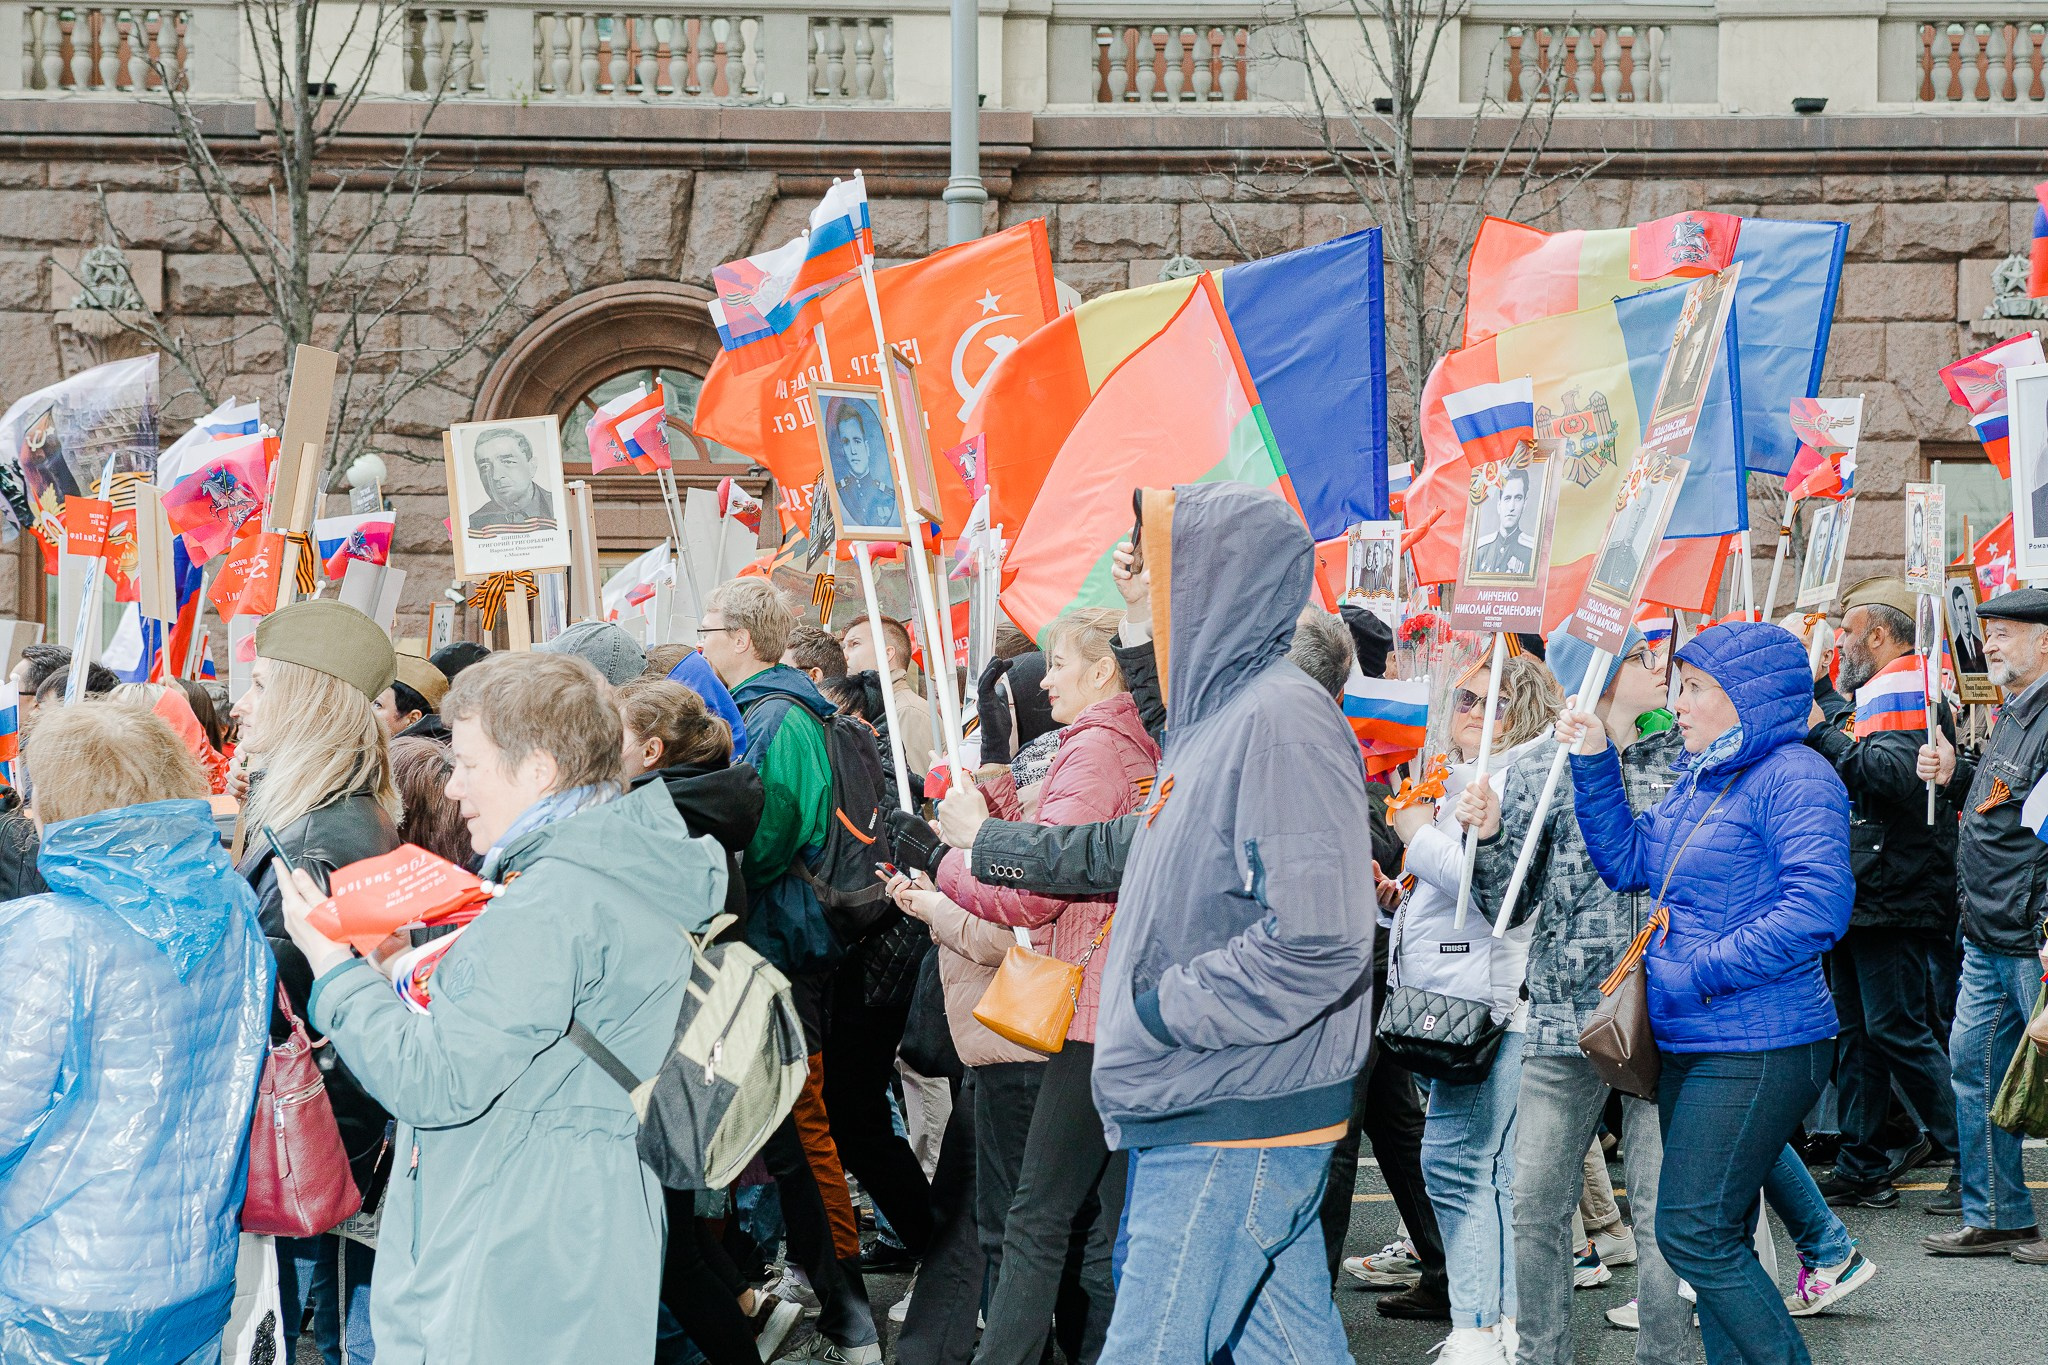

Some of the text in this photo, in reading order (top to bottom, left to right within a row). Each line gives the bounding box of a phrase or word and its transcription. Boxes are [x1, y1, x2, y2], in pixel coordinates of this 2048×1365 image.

[1477, 591, 1518, 602] ЛИНЧЕНКО
[1455, 602, 1542, 617] НИКОЛАЙ СЕМЕНОВИЧ
[1442, 944, 1467, 952] TRUST
[1423, 1015, 1436, 1030] B
